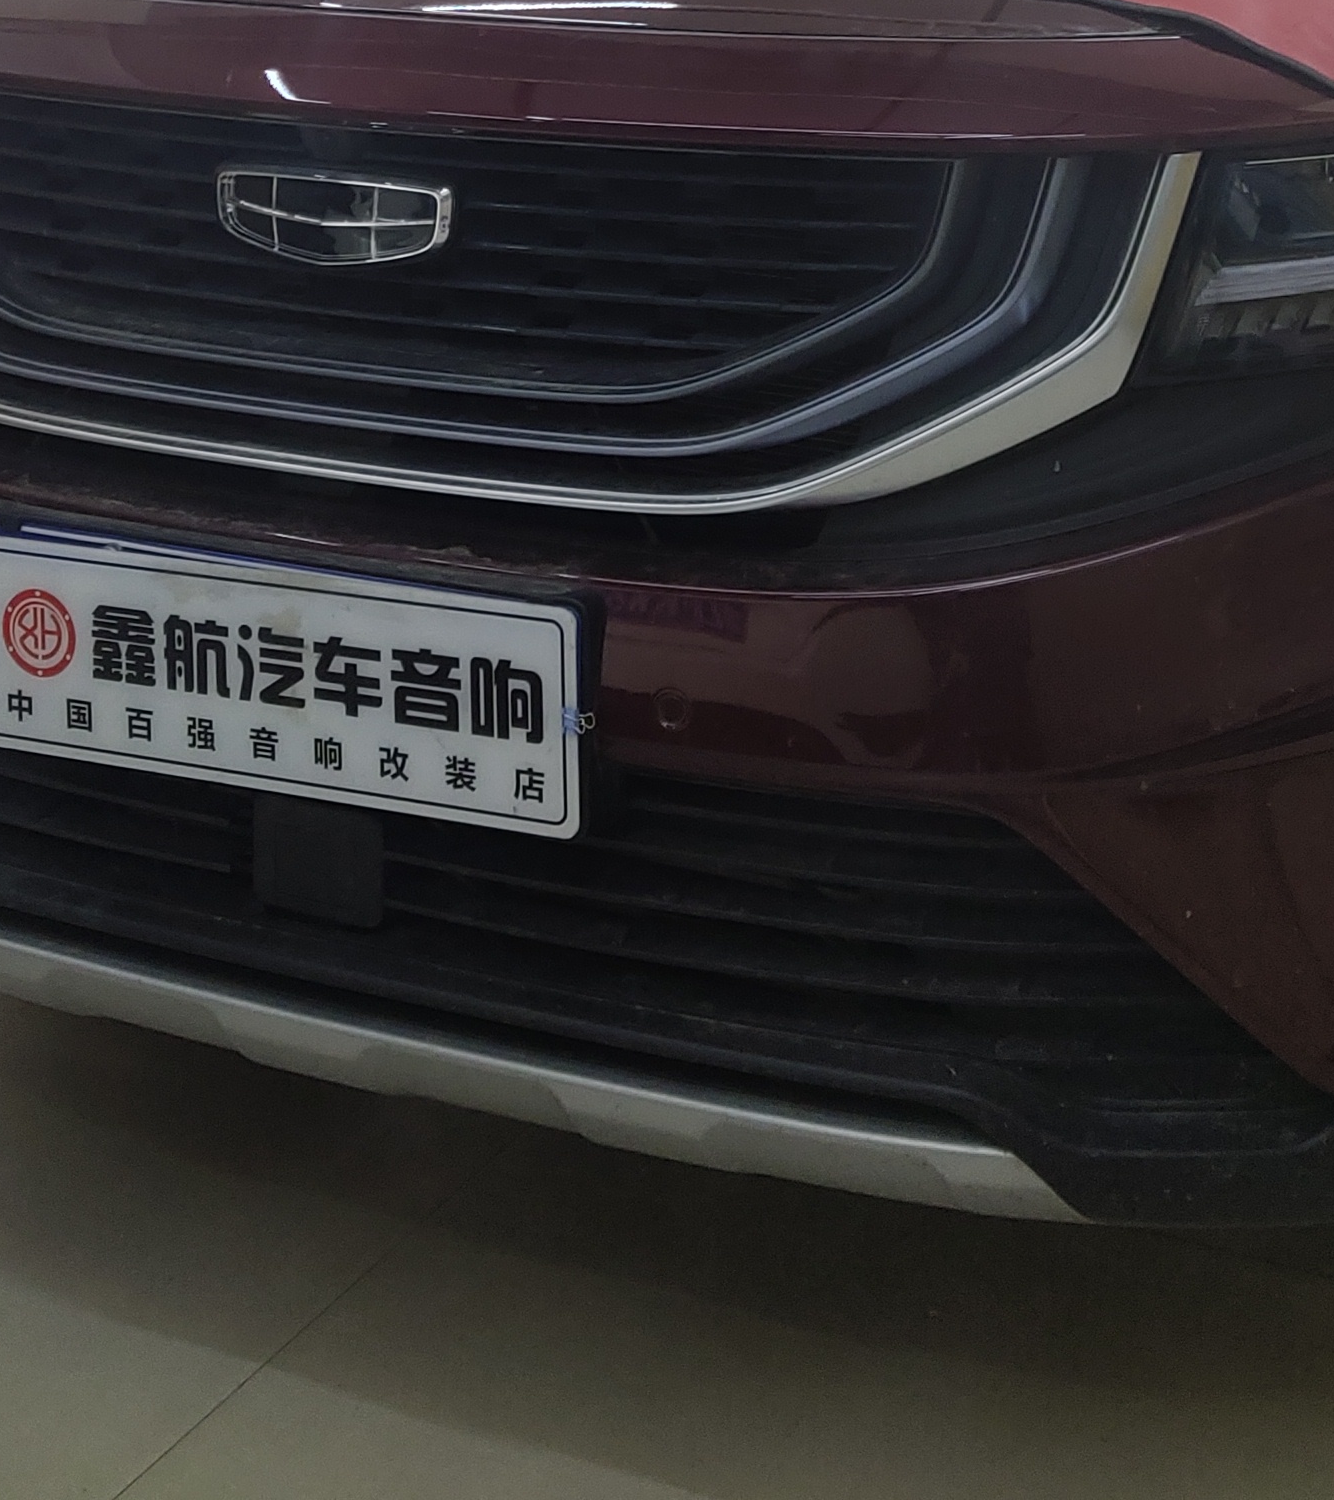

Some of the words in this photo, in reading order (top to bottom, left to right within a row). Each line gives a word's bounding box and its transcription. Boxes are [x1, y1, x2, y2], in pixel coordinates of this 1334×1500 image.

[91, 604, 544, 745] 鑫航汽车音响
[6, 689, 546, 805] 中国百强音响改装店
